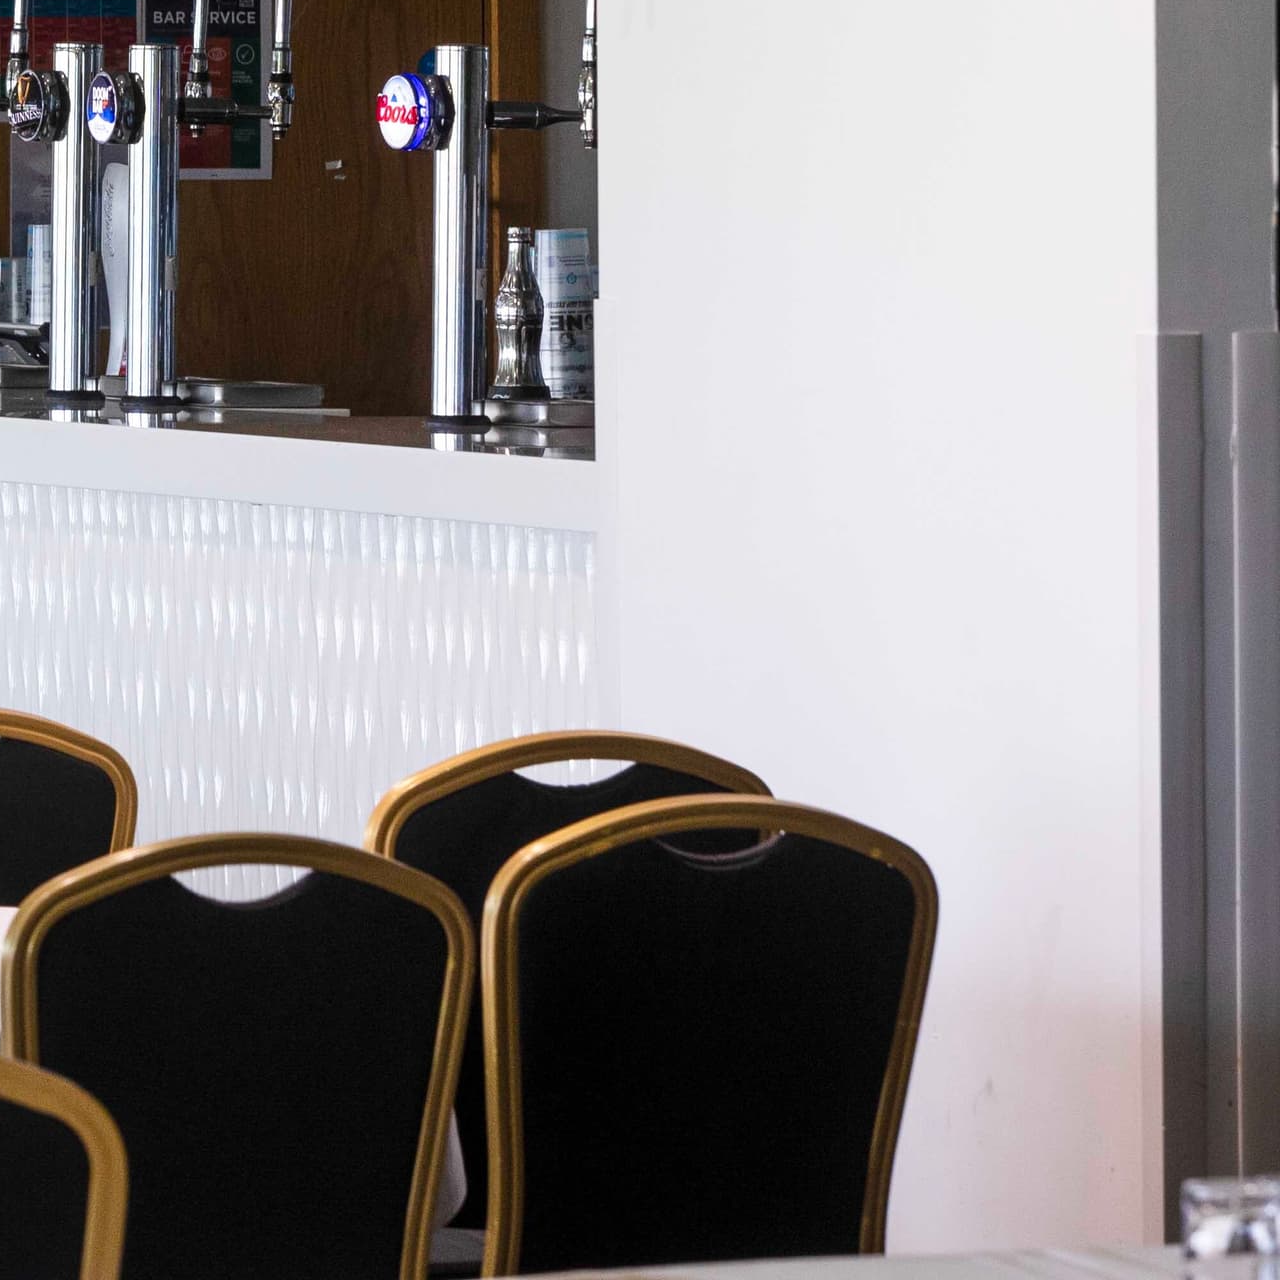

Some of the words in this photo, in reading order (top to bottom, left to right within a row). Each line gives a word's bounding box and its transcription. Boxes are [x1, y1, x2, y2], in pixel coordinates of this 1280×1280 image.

[153, 11, 186, 24] BAR
[190, 11, 256, 24] SRVICE
[376, 94, 418, 125] Coors
